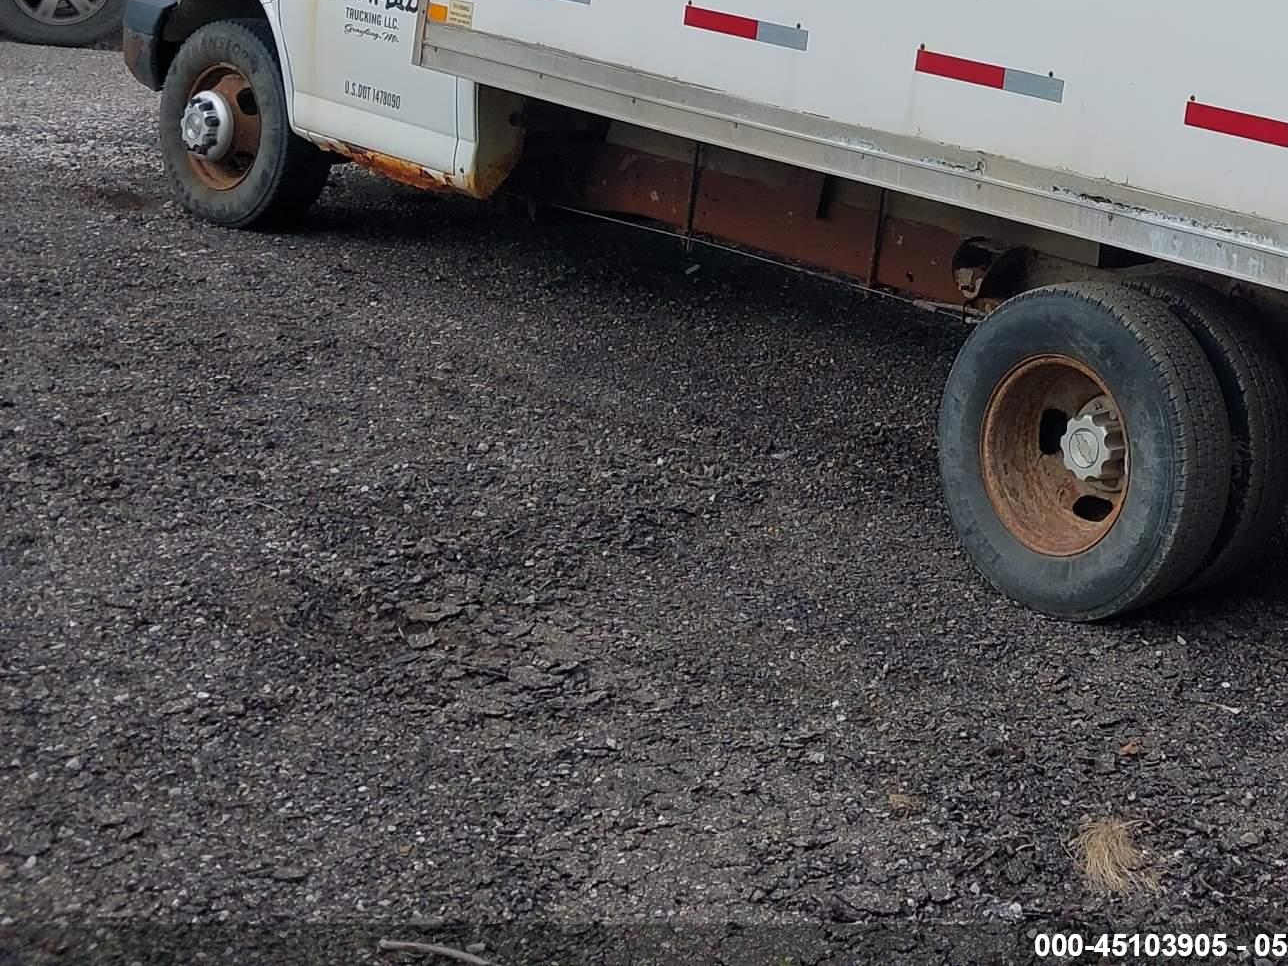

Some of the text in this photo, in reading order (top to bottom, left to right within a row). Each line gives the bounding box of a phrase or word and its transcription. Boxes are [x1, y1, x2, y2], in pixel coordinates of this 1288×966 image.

[345, 7, 400, 31] TRUCKING LLC.
[372, 88, 401, 110] 1478090
